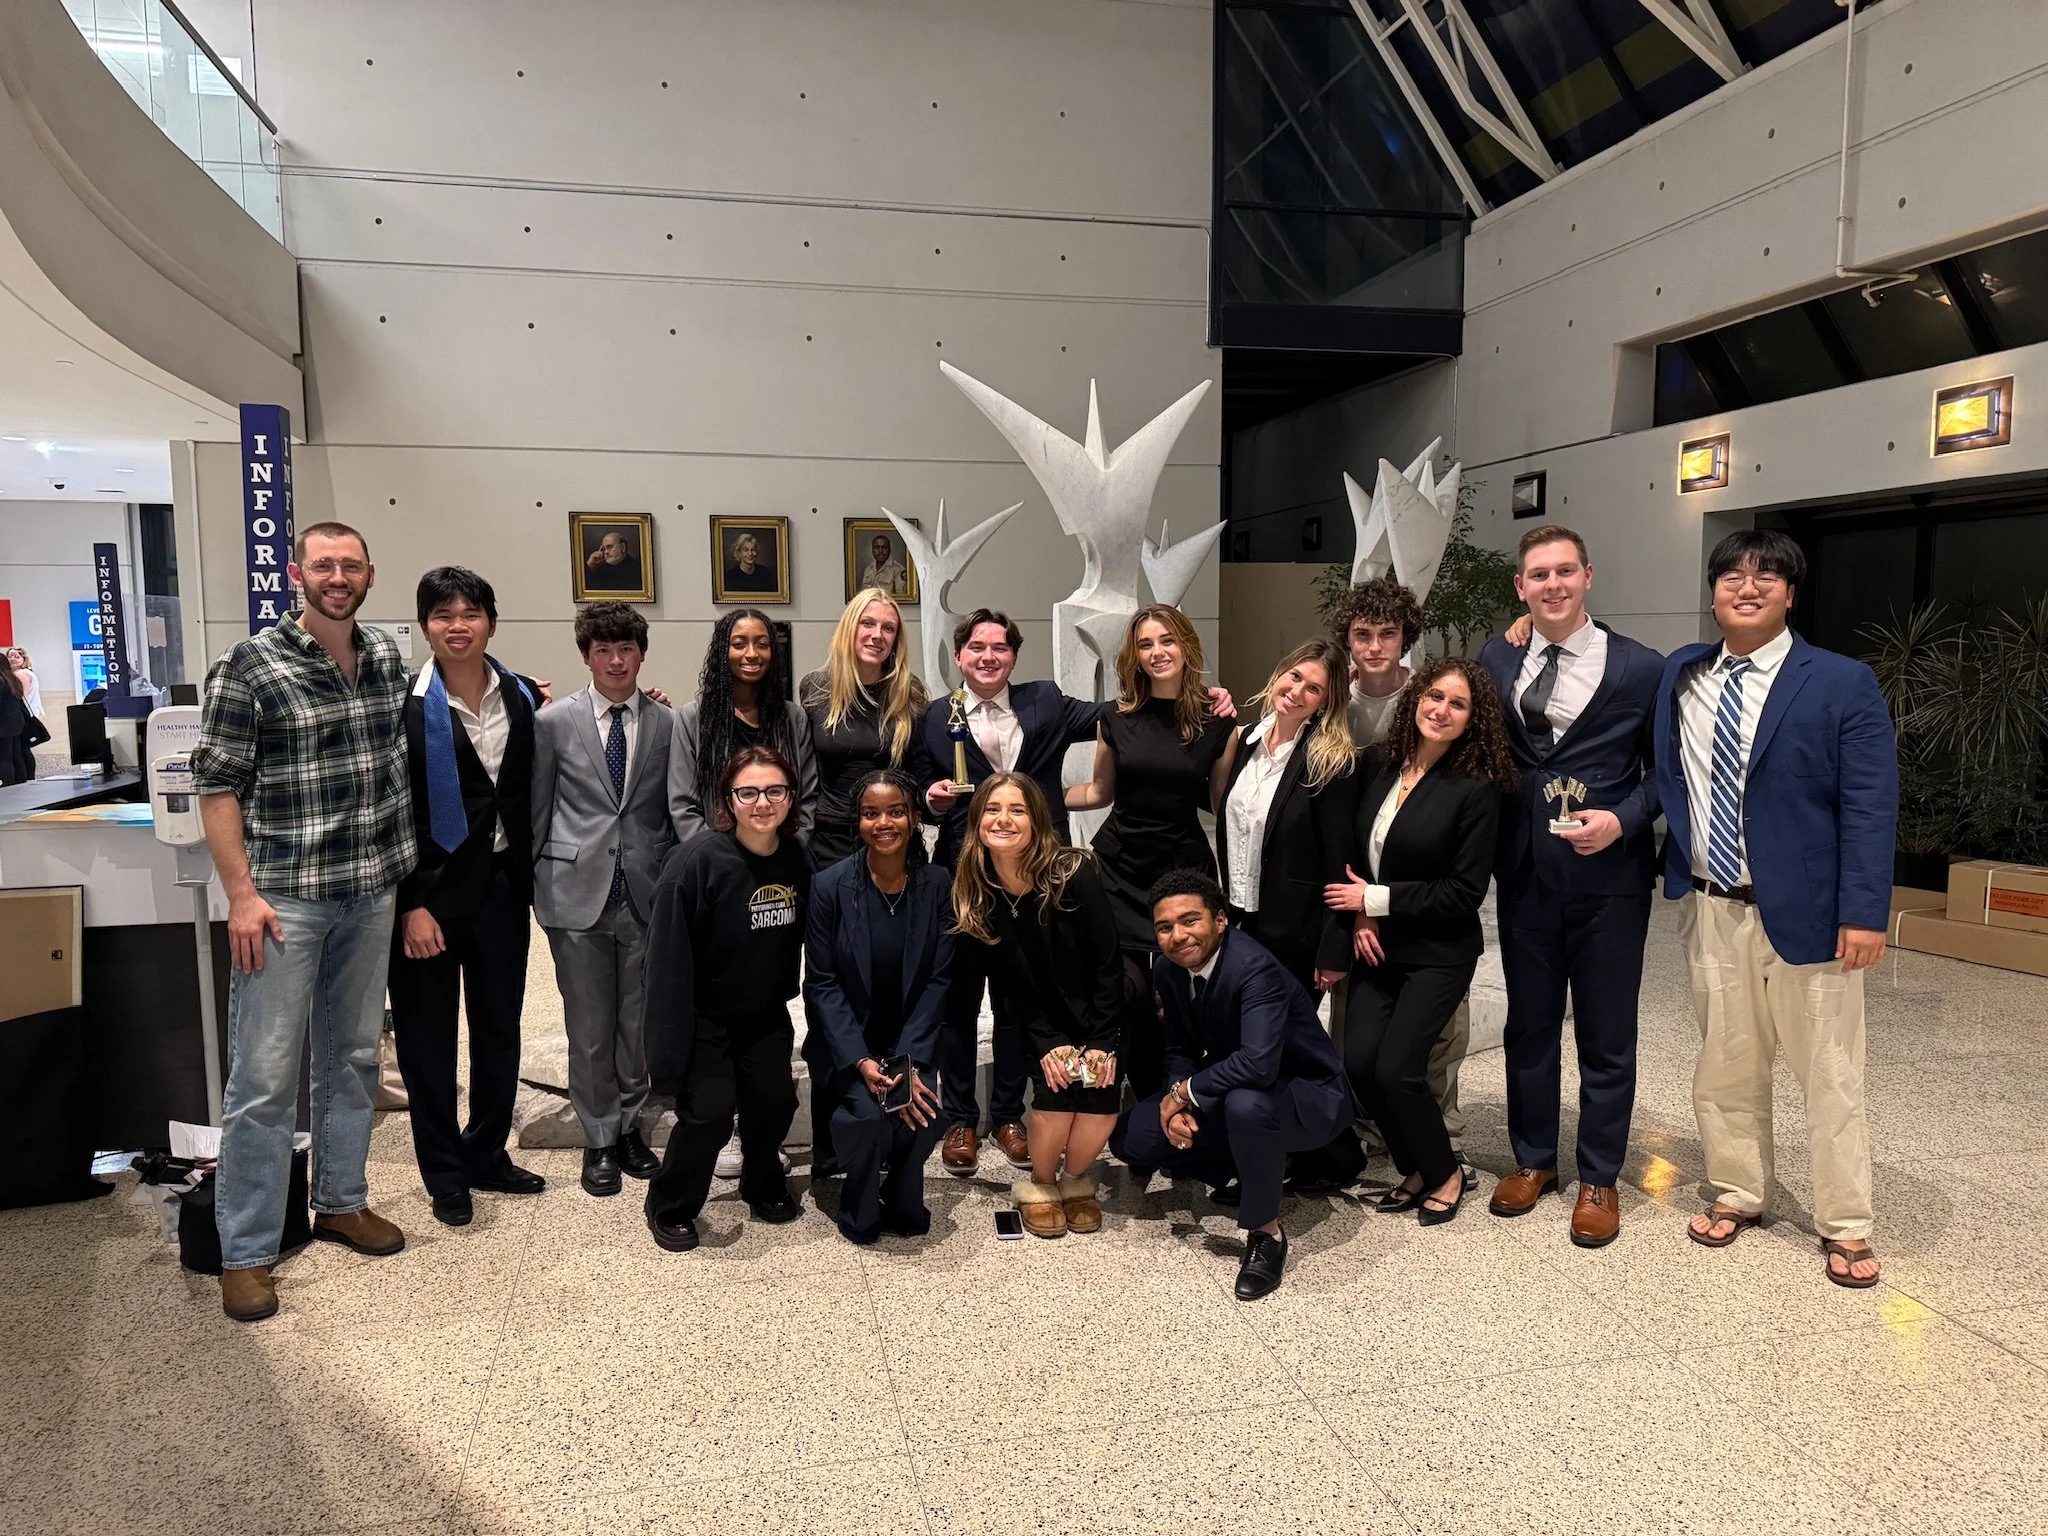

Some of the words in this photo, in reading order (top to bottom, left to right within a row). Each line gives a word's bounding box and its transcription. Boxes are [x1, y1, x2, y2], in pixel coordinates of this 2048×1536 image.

[250, 434, 282, 620] INFORMA
[99, 556, 120, 684] INFORMATION
[160, 731, 187, 739] START
[751, 907, 796, 930] SARCOMA
